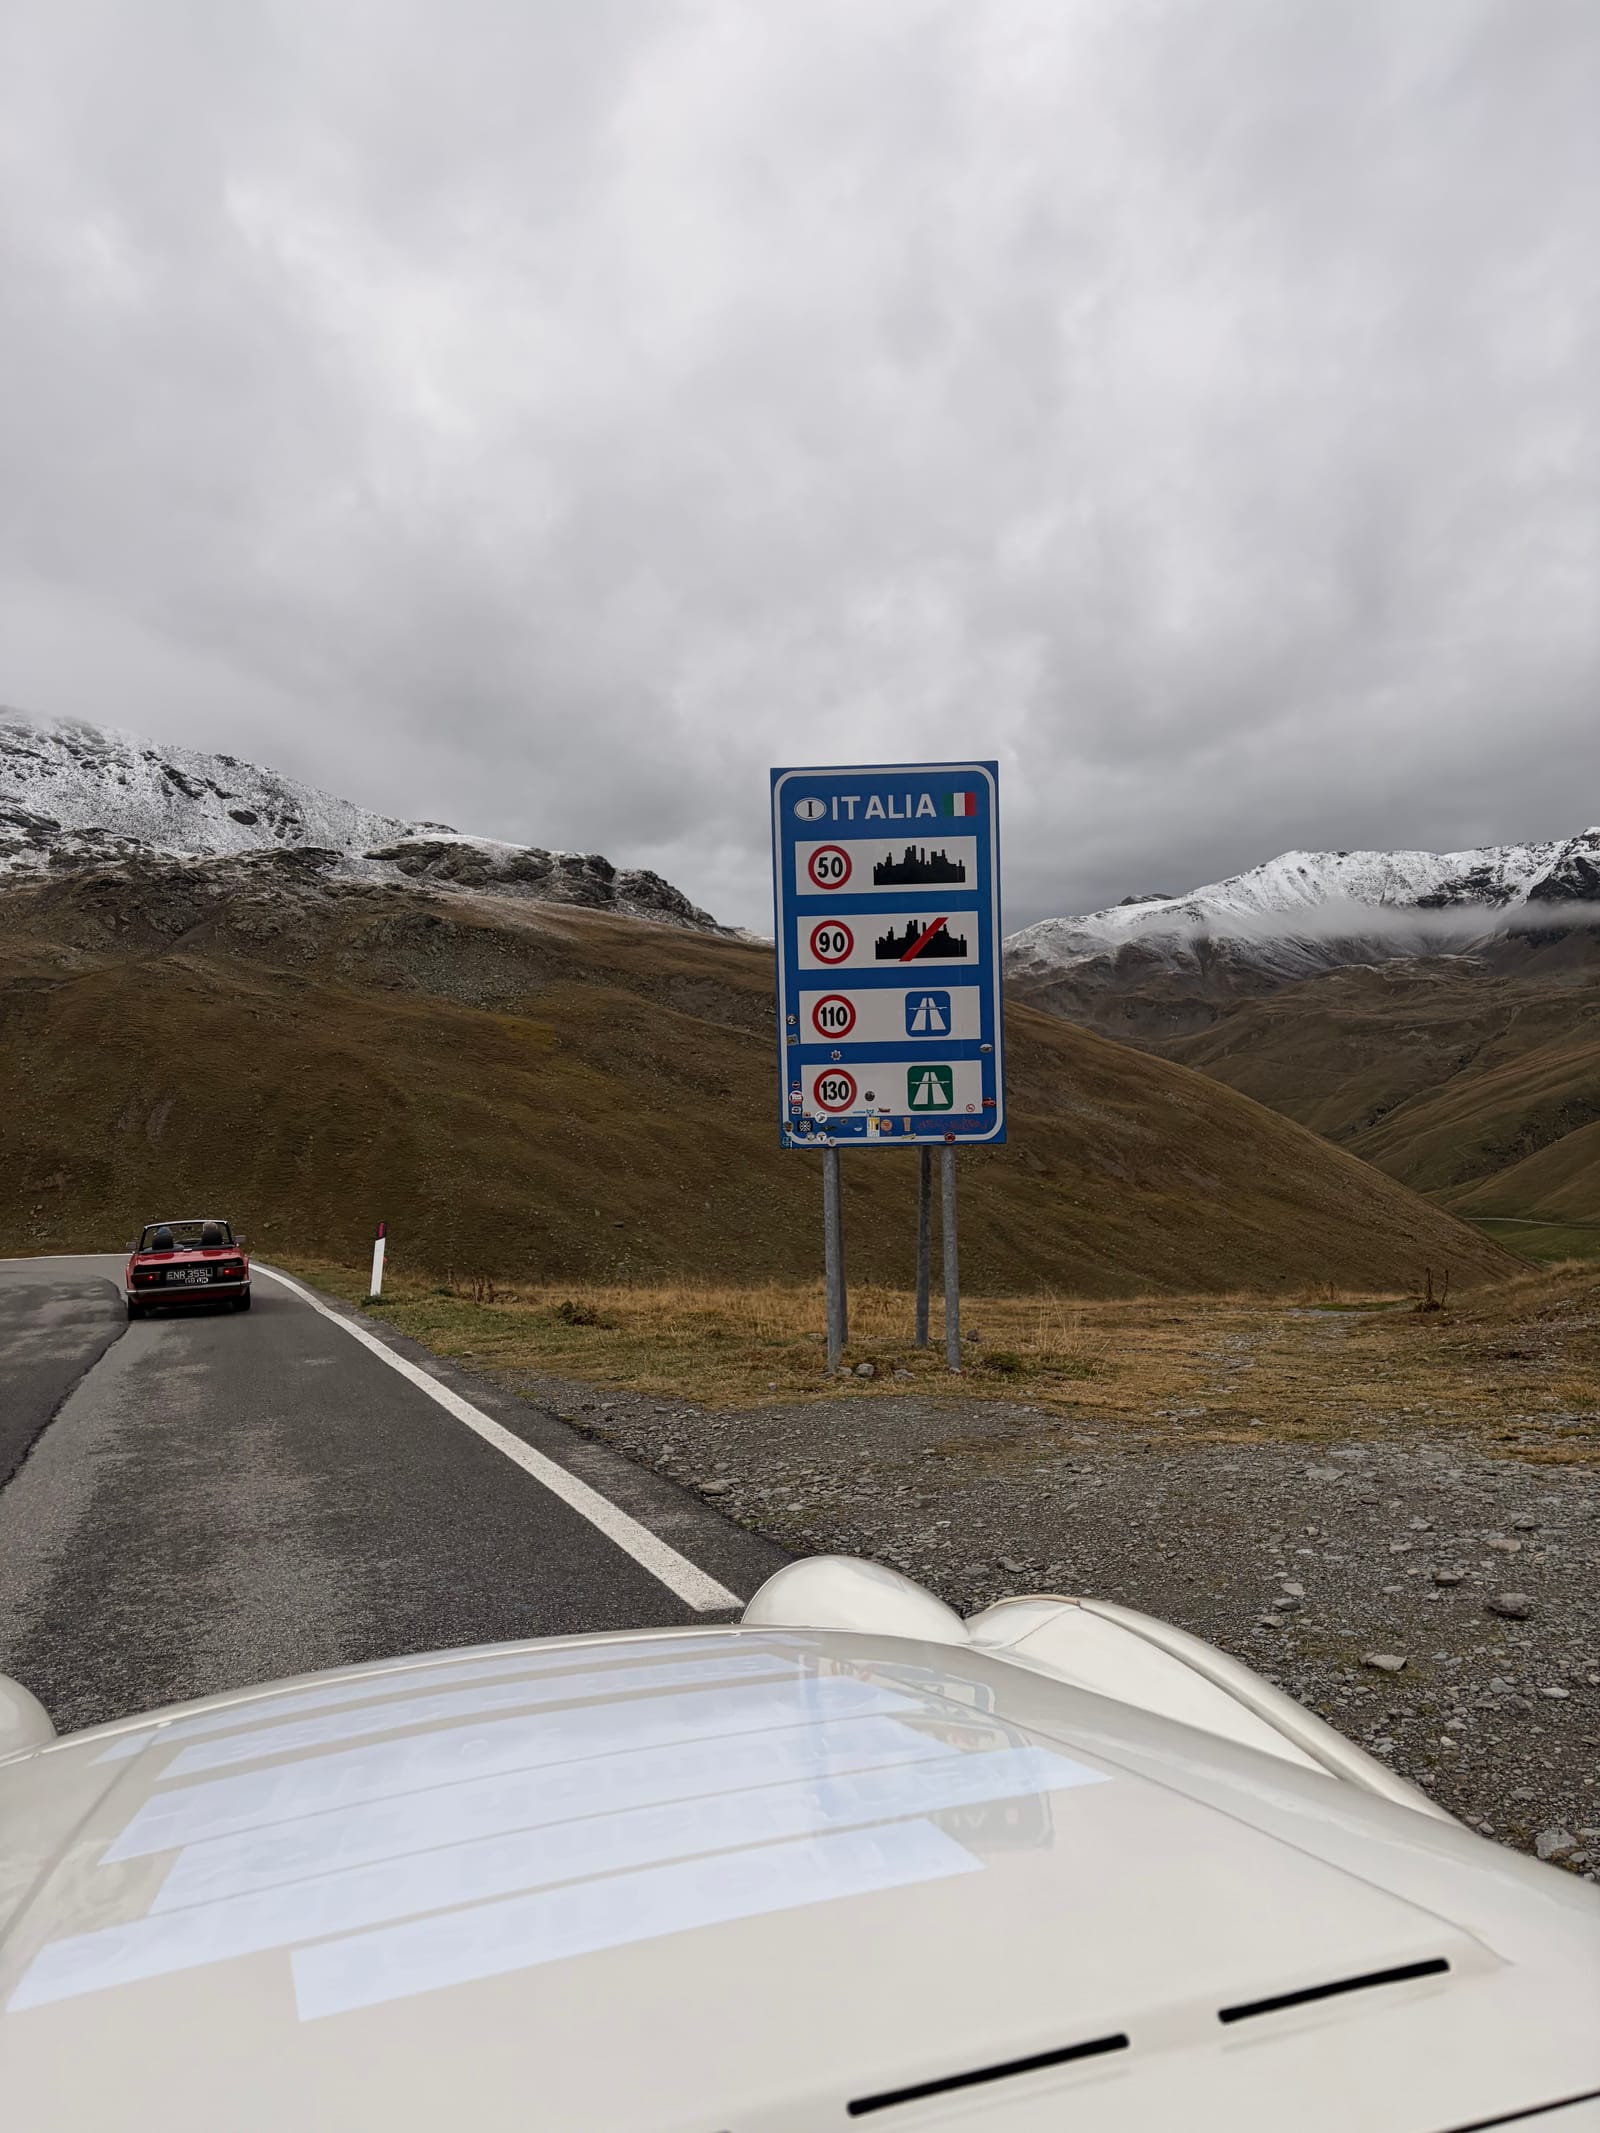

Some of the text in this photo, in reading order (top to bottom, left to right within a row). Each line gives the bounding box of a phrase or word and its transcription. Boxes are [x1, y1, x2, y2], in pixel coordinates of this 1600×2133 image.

[831, 793, 937, 821] ITALIA
[817, 856, 843, 878] 50
[818, 931, 845, 953] 90
[820, 1006, 848, 1027] 110
[821, 1080, 850, 1101] 130
